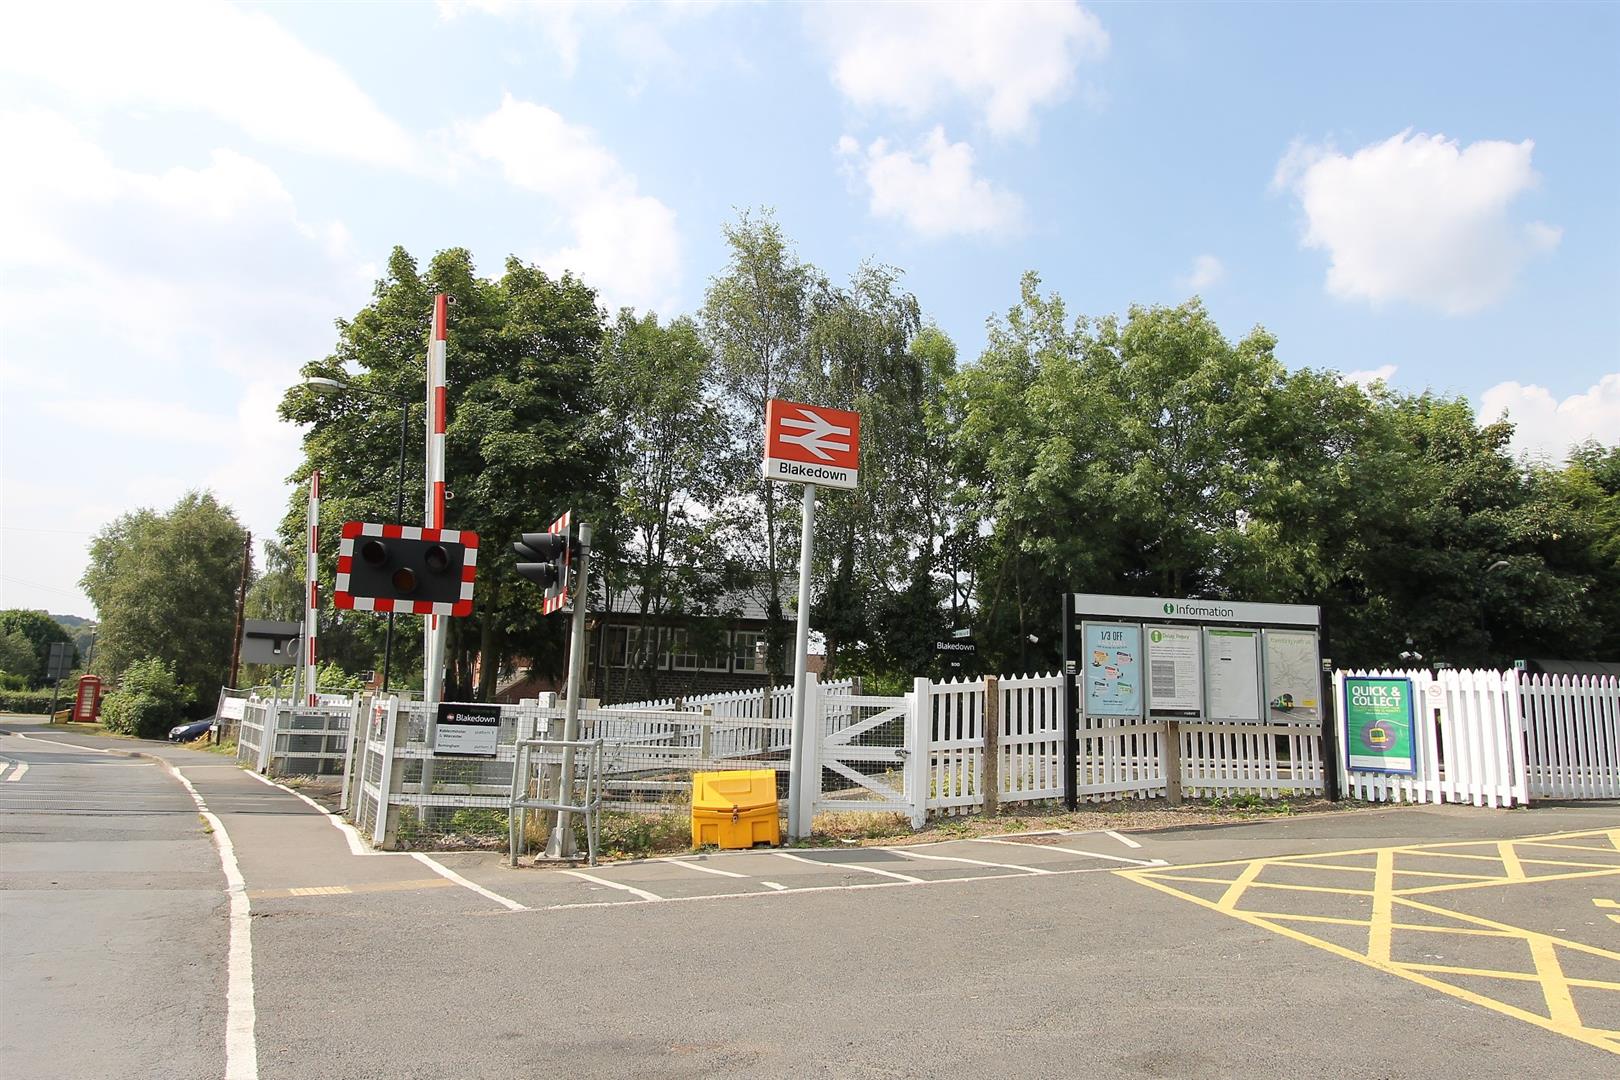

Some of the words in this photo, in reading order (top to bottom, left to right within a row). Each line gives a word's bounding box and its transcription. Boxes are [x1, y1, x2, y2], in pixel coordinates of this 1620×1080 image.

[779, 462, 847, 481] Blakedown
[1176, 604, 1234, 617] Information
[1101, 631, 1111, 641] 1/3
[1112, 631, 1123, 641] OFF
[936, 641, 975, 651] Blakedown
[1352, 685, 1388, 697] QUICK
[1390, 686, 1401, 697] &
[1352, 696, 1401, 707] COLLECT
[455, 713, 496, 723] Blakedown
